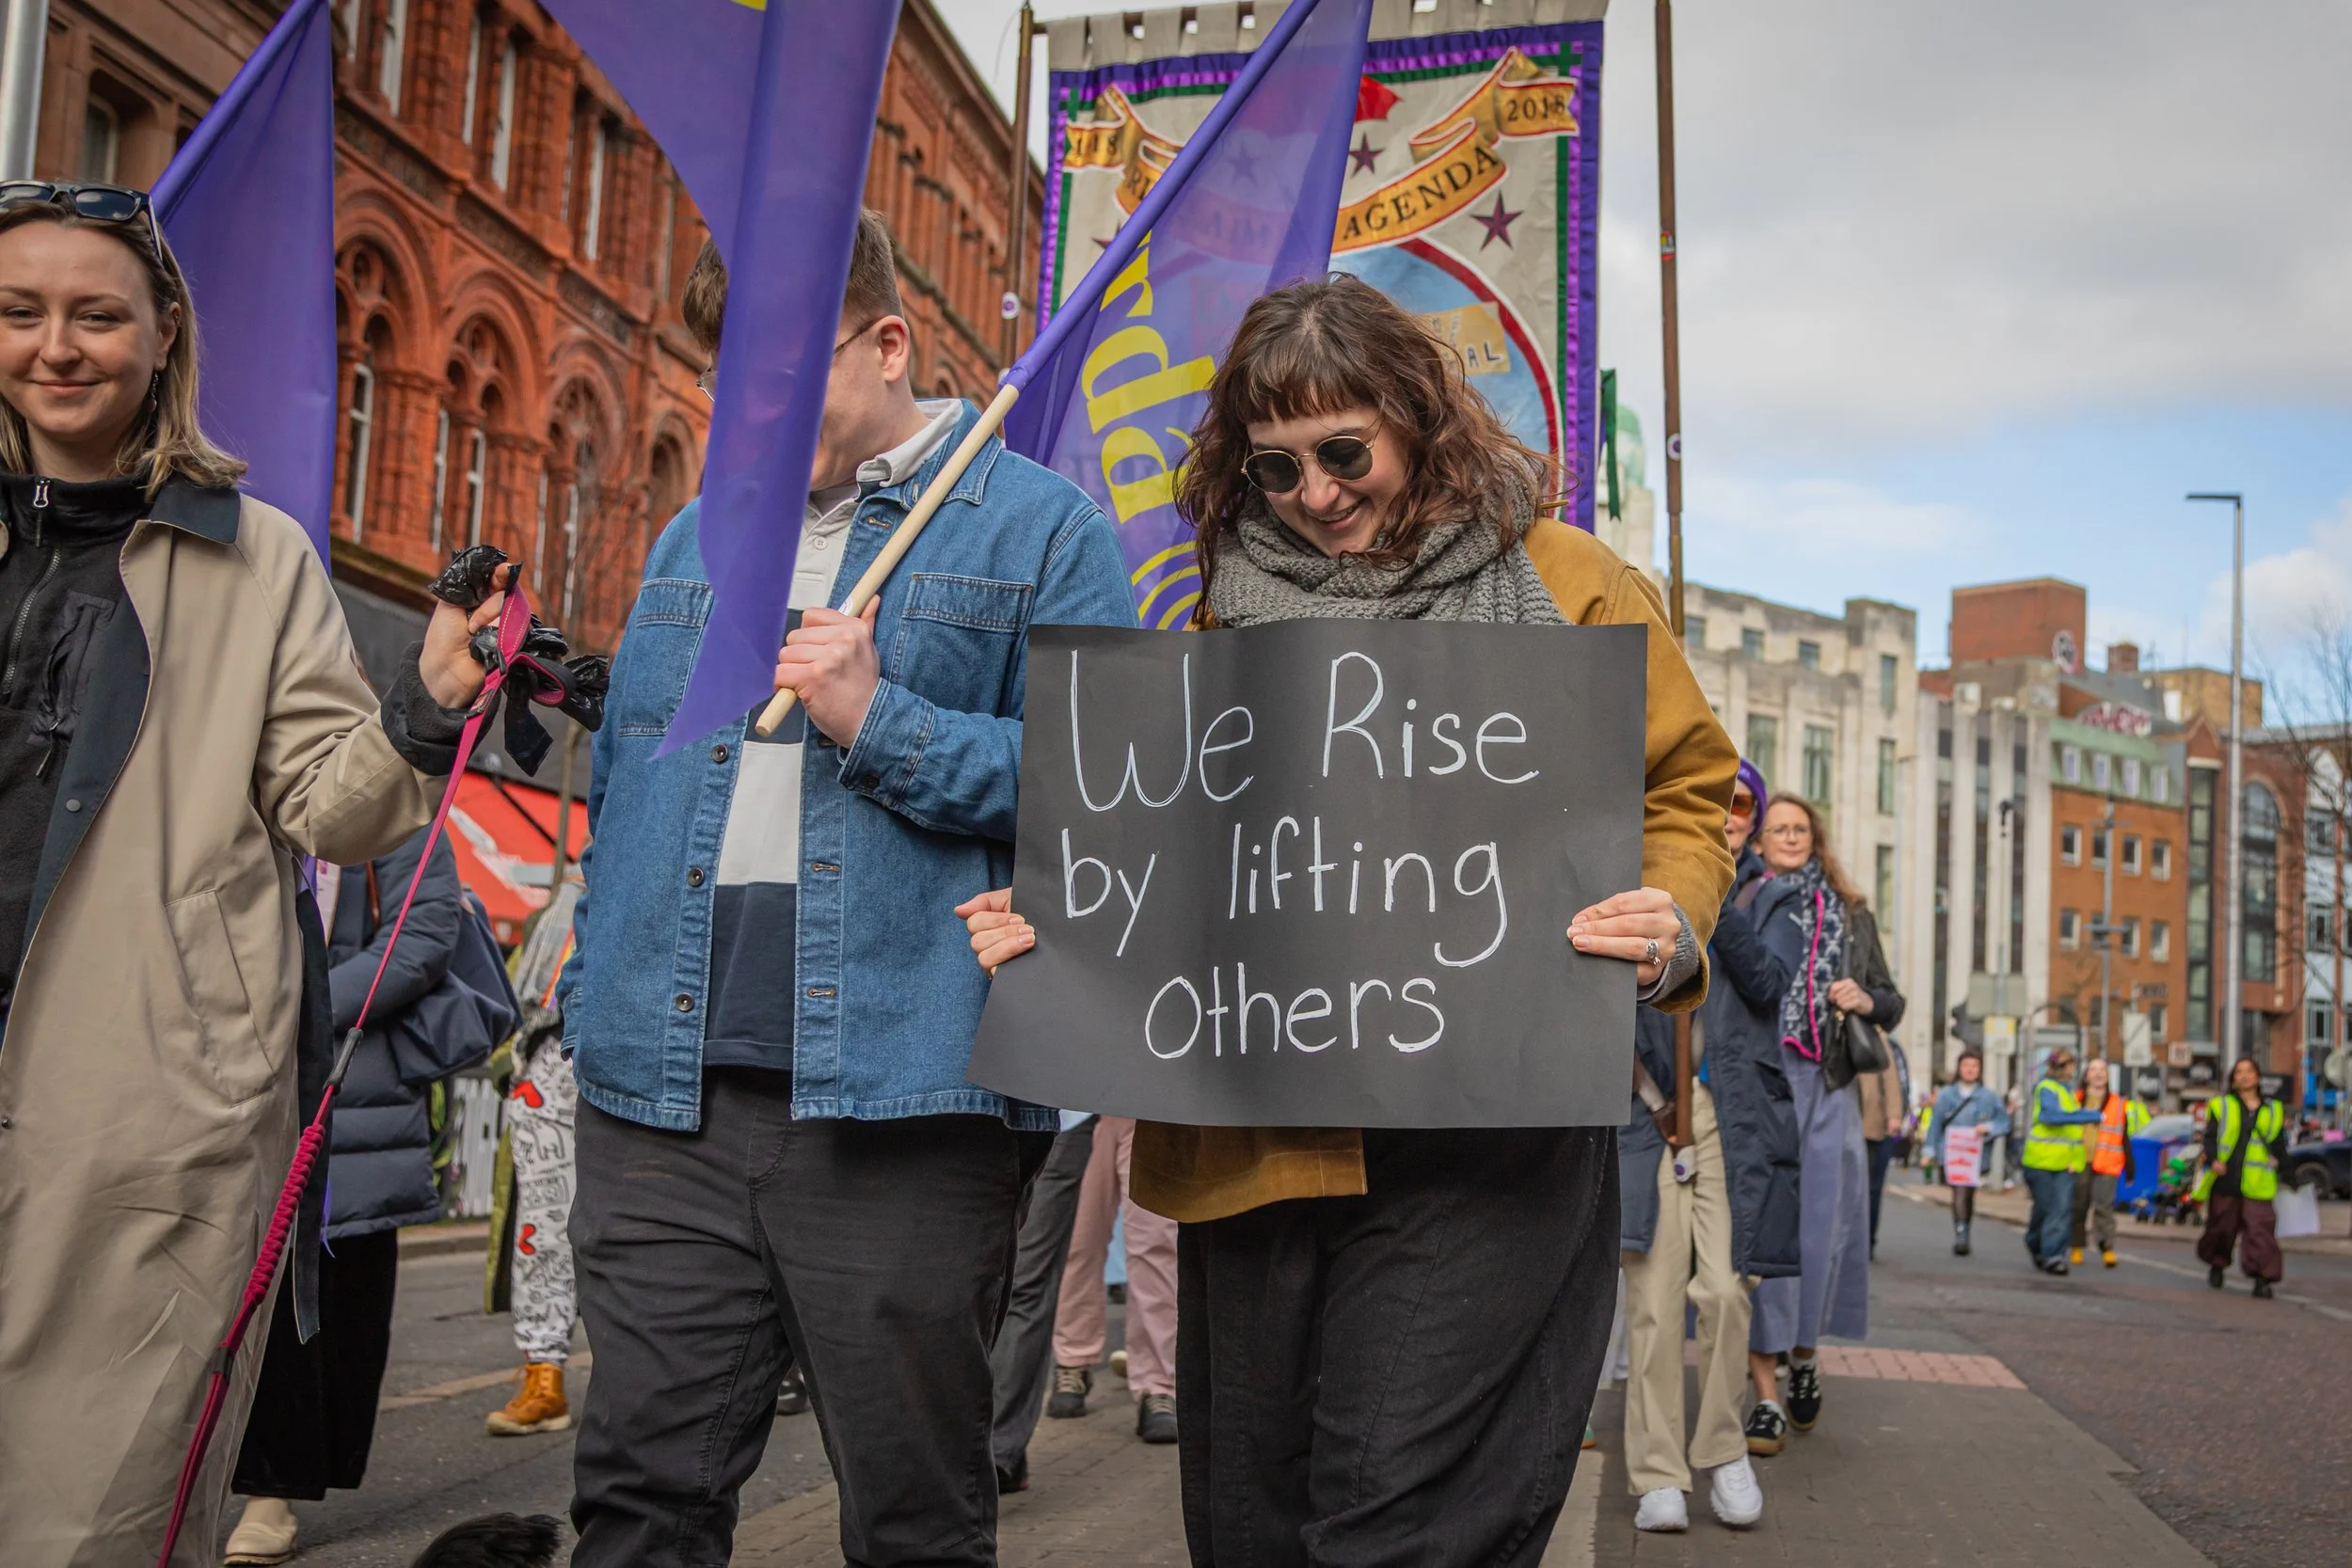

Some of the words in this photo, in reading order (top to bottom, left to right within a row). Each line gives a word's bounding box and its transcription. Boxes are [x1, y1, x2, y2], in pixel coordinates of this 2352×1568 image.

[1507, 94, 1566, 122] 2018
[1343, 144, 1499, 241] AGENDA
[1071, 649, 1254, 813] We
[1322, 651, 1540, 784] Rise
[1061, 828, 1159, 958] by
[1229, 815, 1508, 968] lifting
